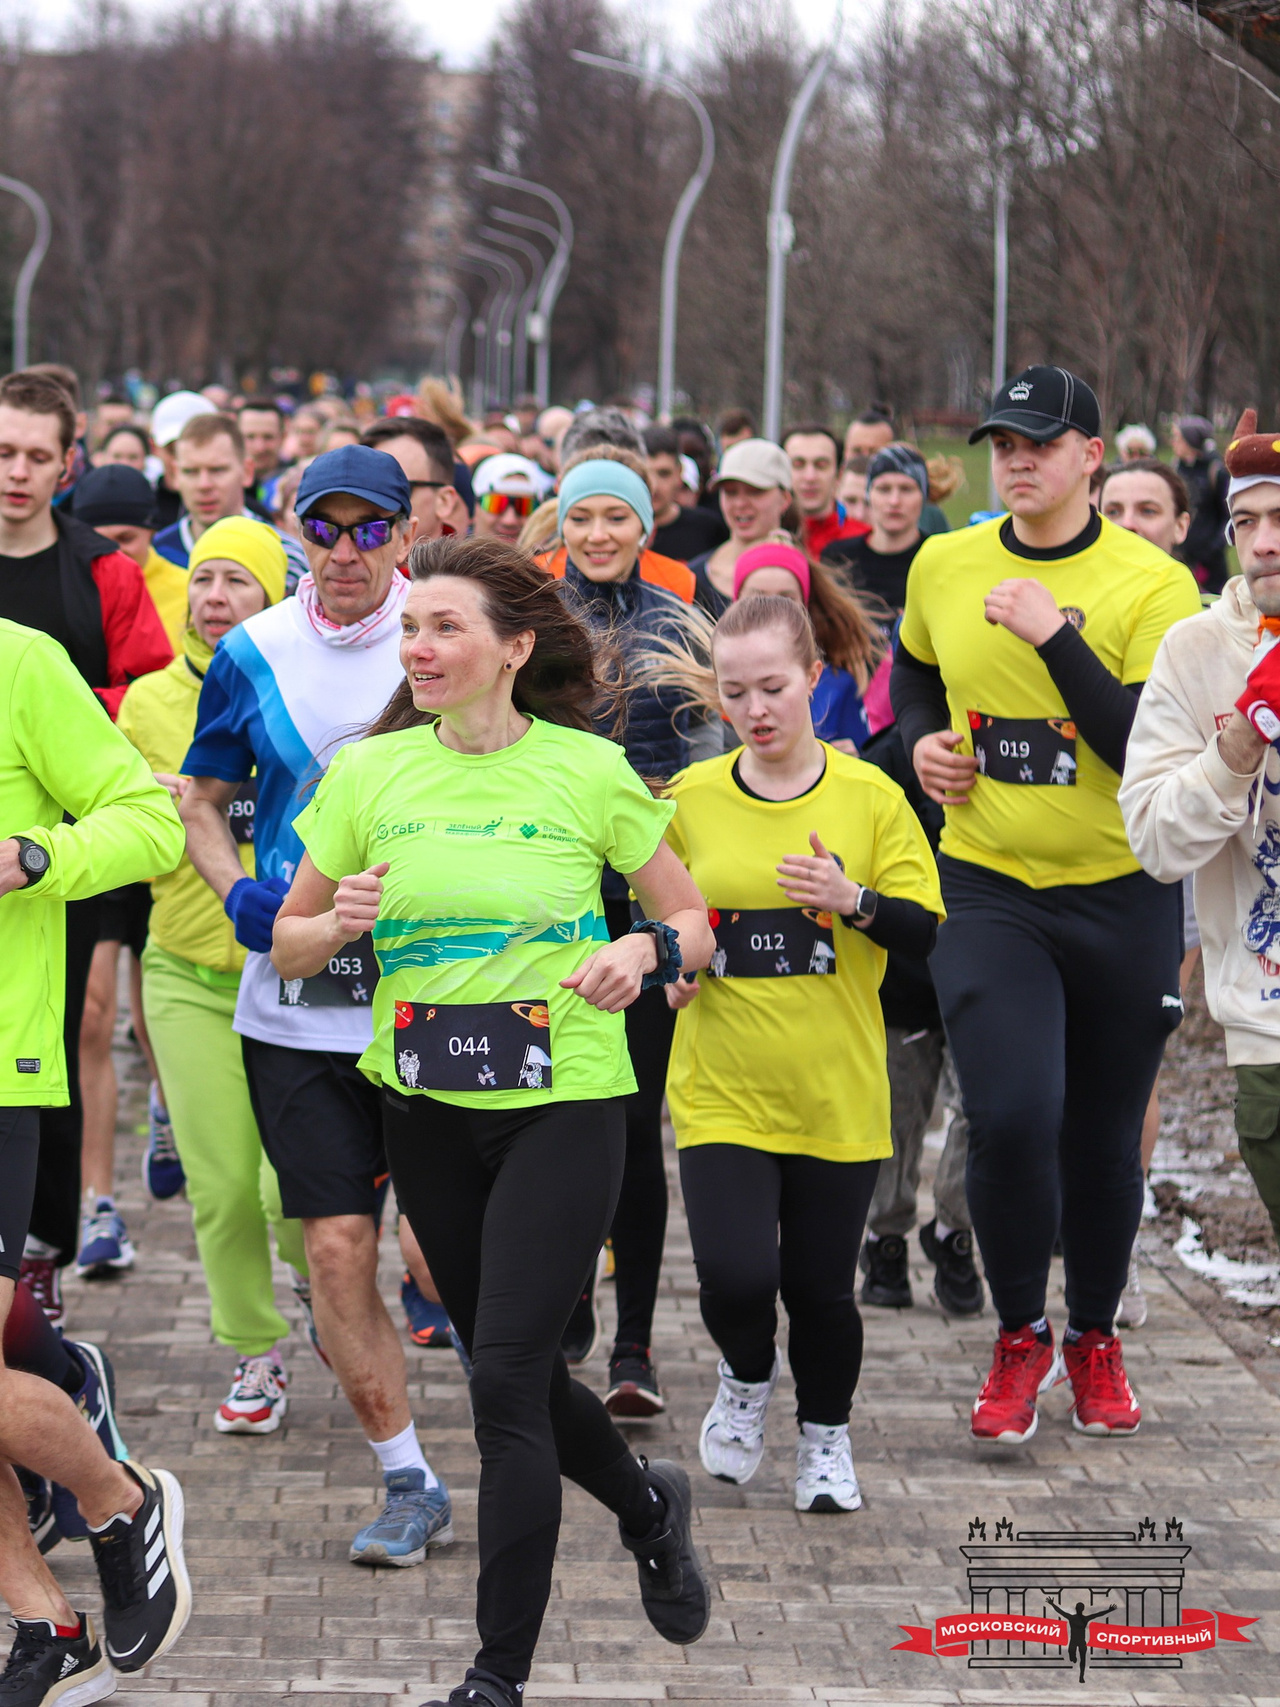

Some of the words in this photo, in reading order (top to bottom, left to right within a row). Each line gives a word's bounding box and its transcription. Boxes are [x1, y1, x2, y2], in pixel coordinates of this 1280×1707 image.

[1000, 739, 1030, 759] 019
[391, 822, 426, 835] СБЕР
[543, 825, 567, 834] Вклад
[750, 933, 785, 951] 012
[328, 958, 363, 975] 053
[448, 1036, 490, 1056] 044
